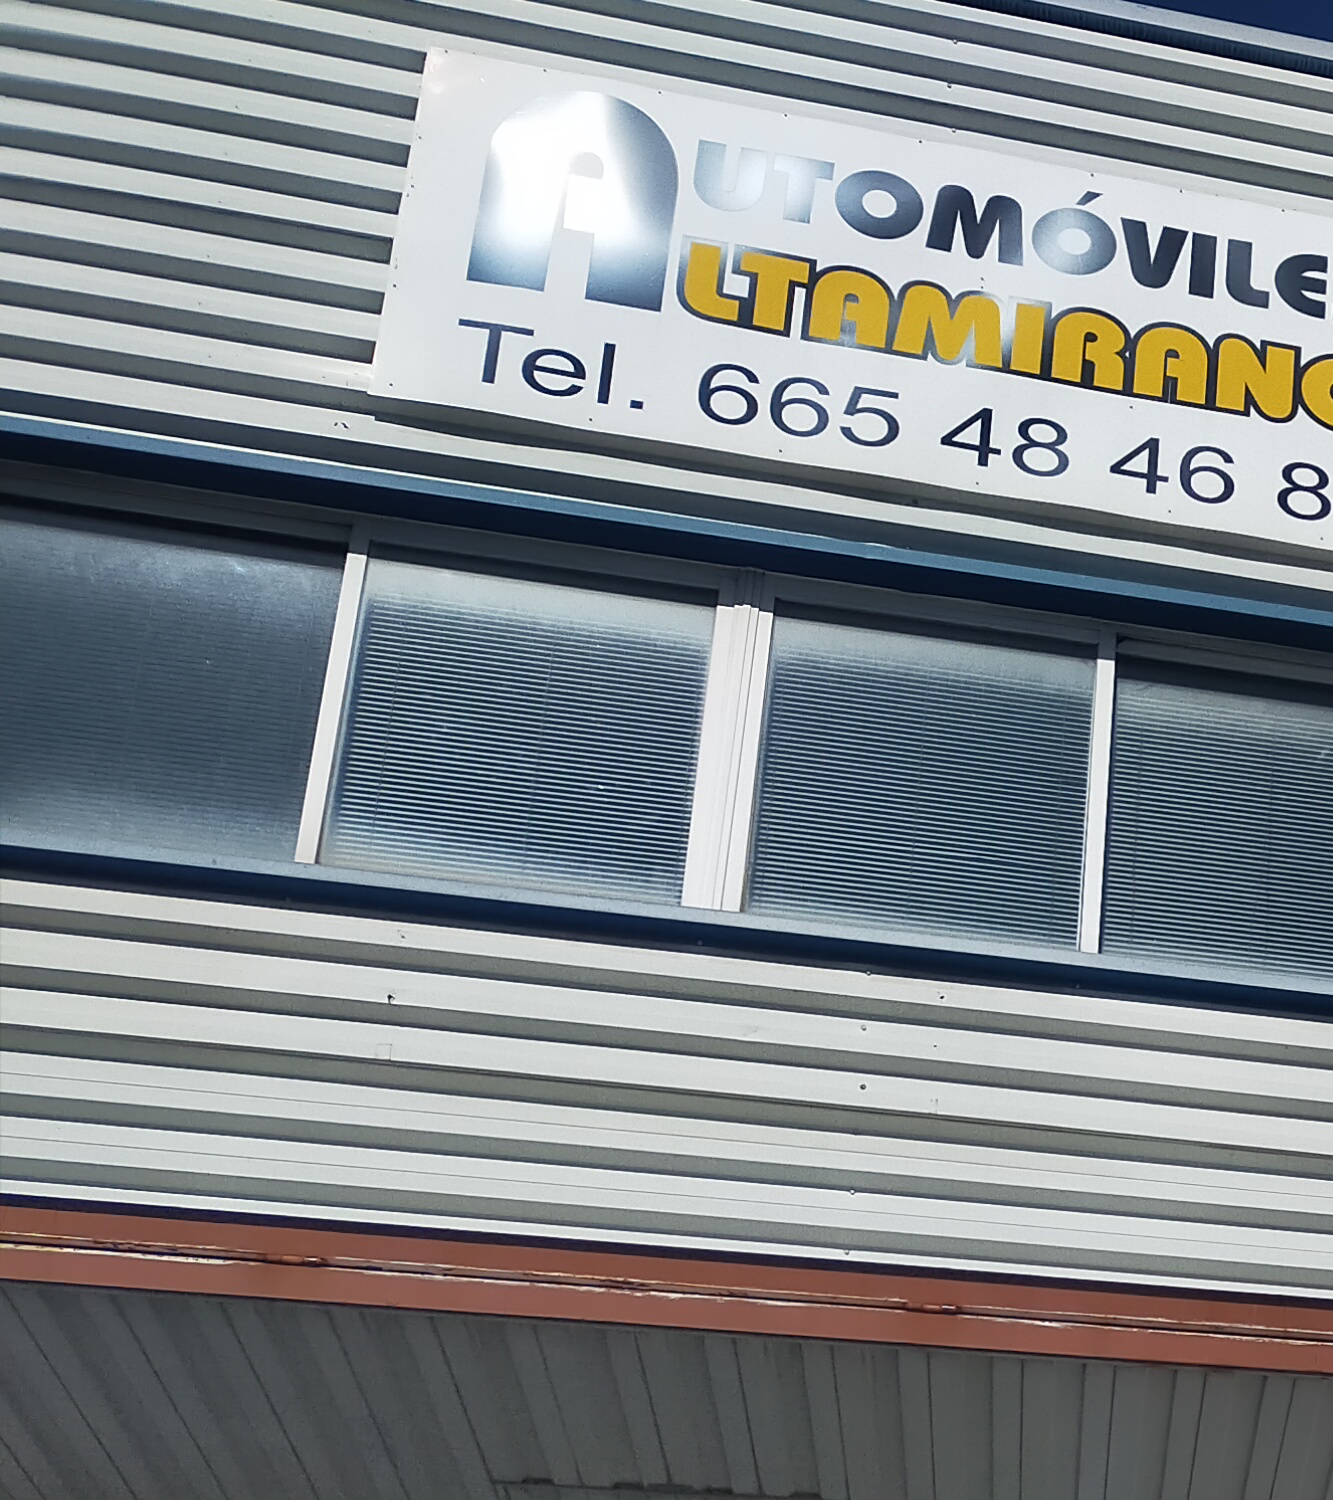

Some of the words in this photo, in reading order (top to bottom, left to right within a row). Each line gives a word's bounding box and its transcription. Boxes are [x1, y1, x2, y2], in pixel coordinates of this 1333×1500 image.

[459, 318, 644, 410] Tel.
[697, 362, 900, 446] 665
[939, 408, 1070, 477] 48
[1109, 437, 1237, 504] 46
